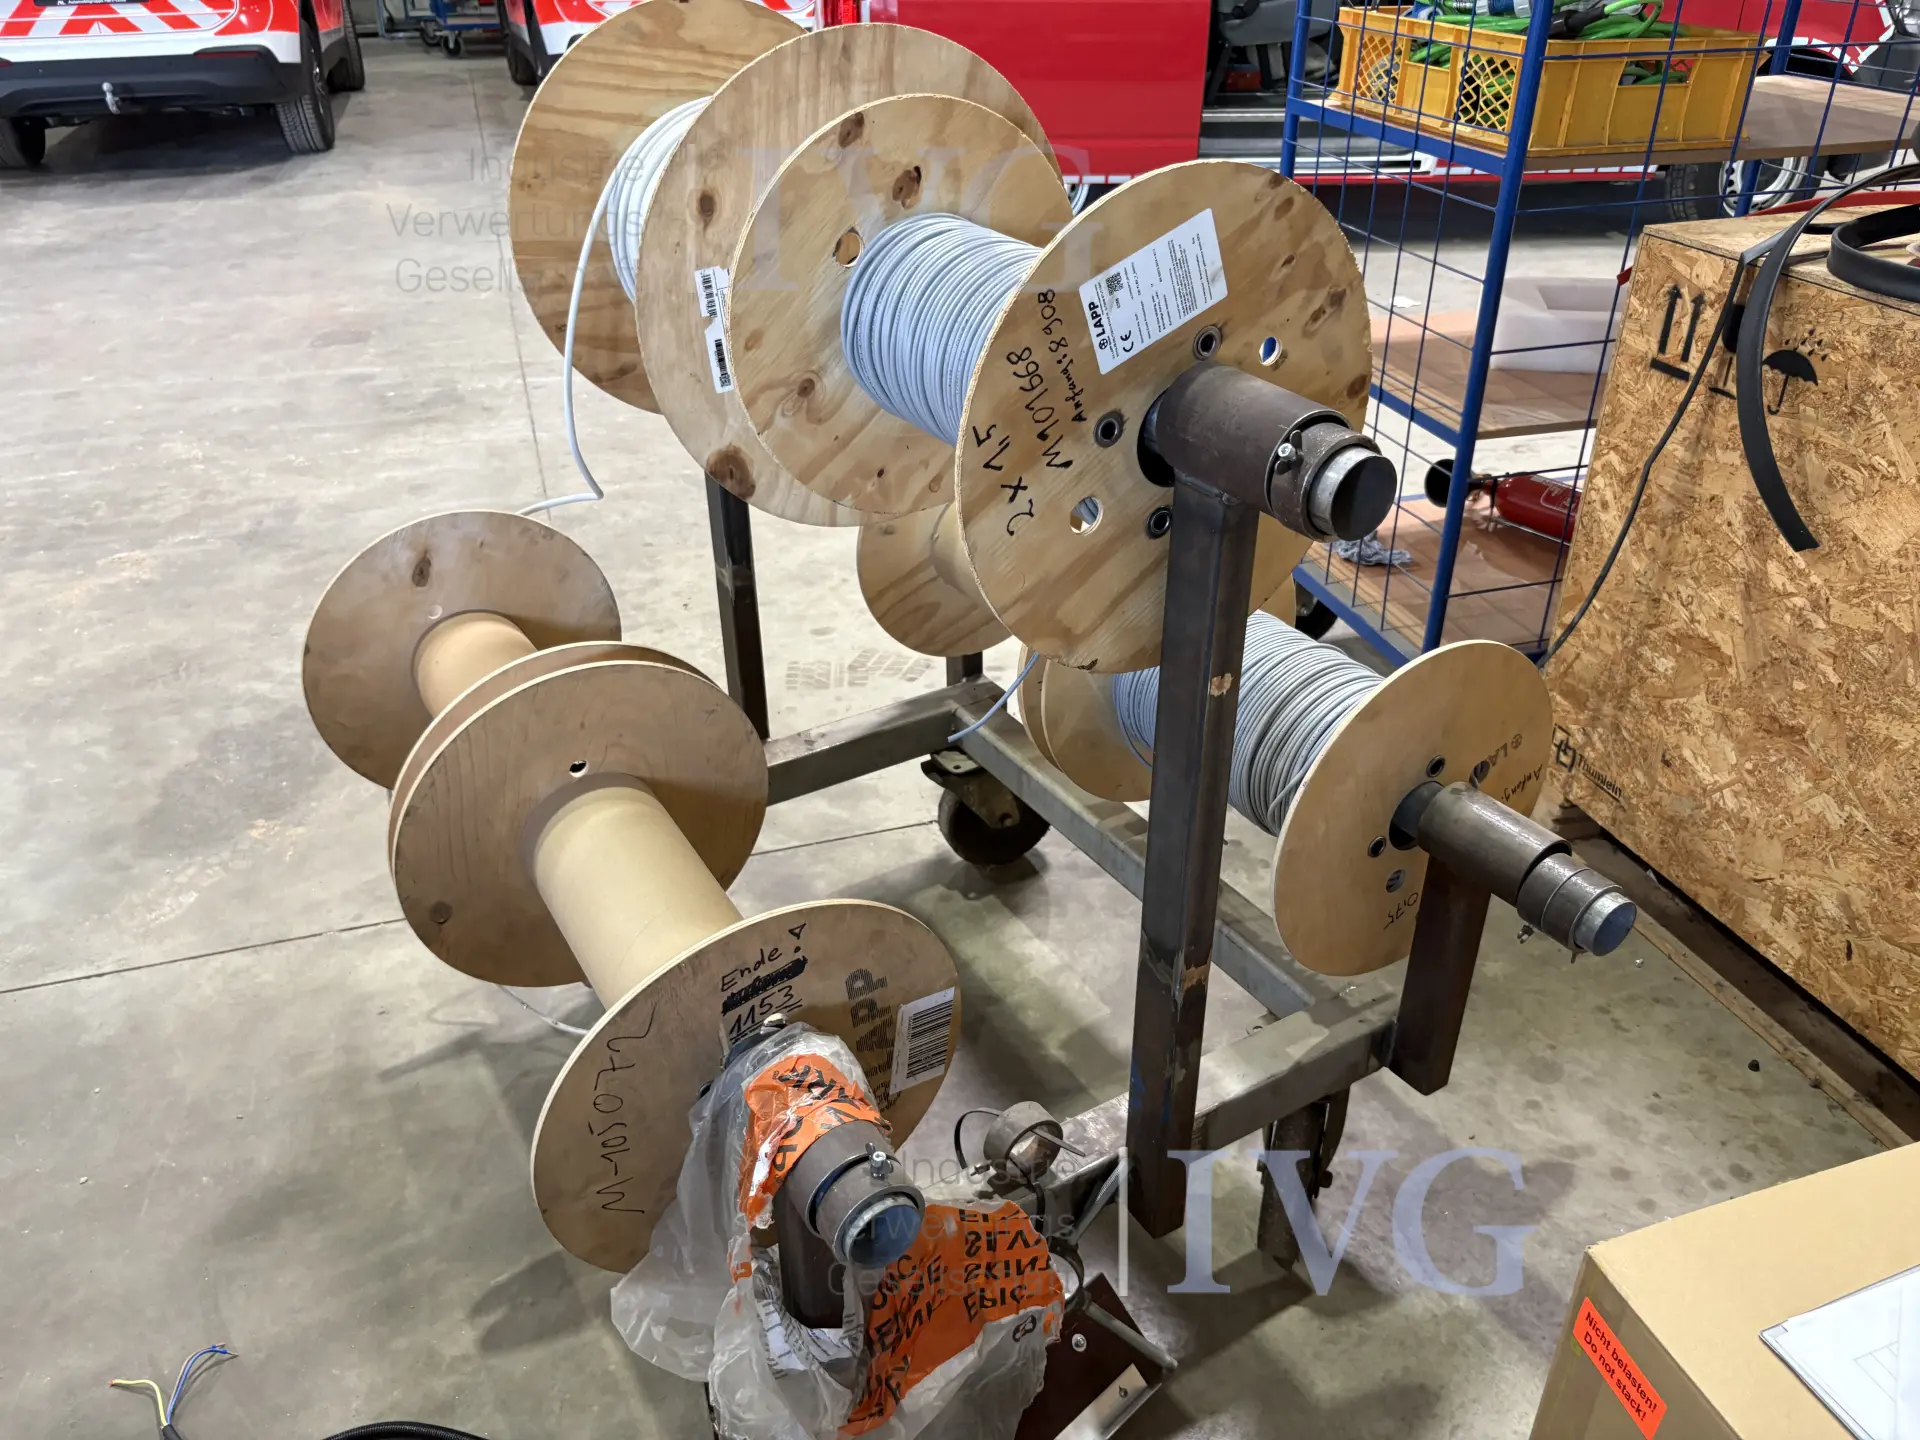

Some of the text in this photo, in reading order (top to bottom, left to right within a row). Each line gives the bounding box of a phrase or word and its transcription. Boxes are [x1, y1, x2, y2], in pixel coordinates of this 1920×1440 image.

[1088, 301, 1107, 338] LAPP
[845, 967, 895, 1079] LAPP
[1583, 1331, 1647, 1422] Do not stack!
[1585, 1311, 1658, 1413] Nicht belasten!
